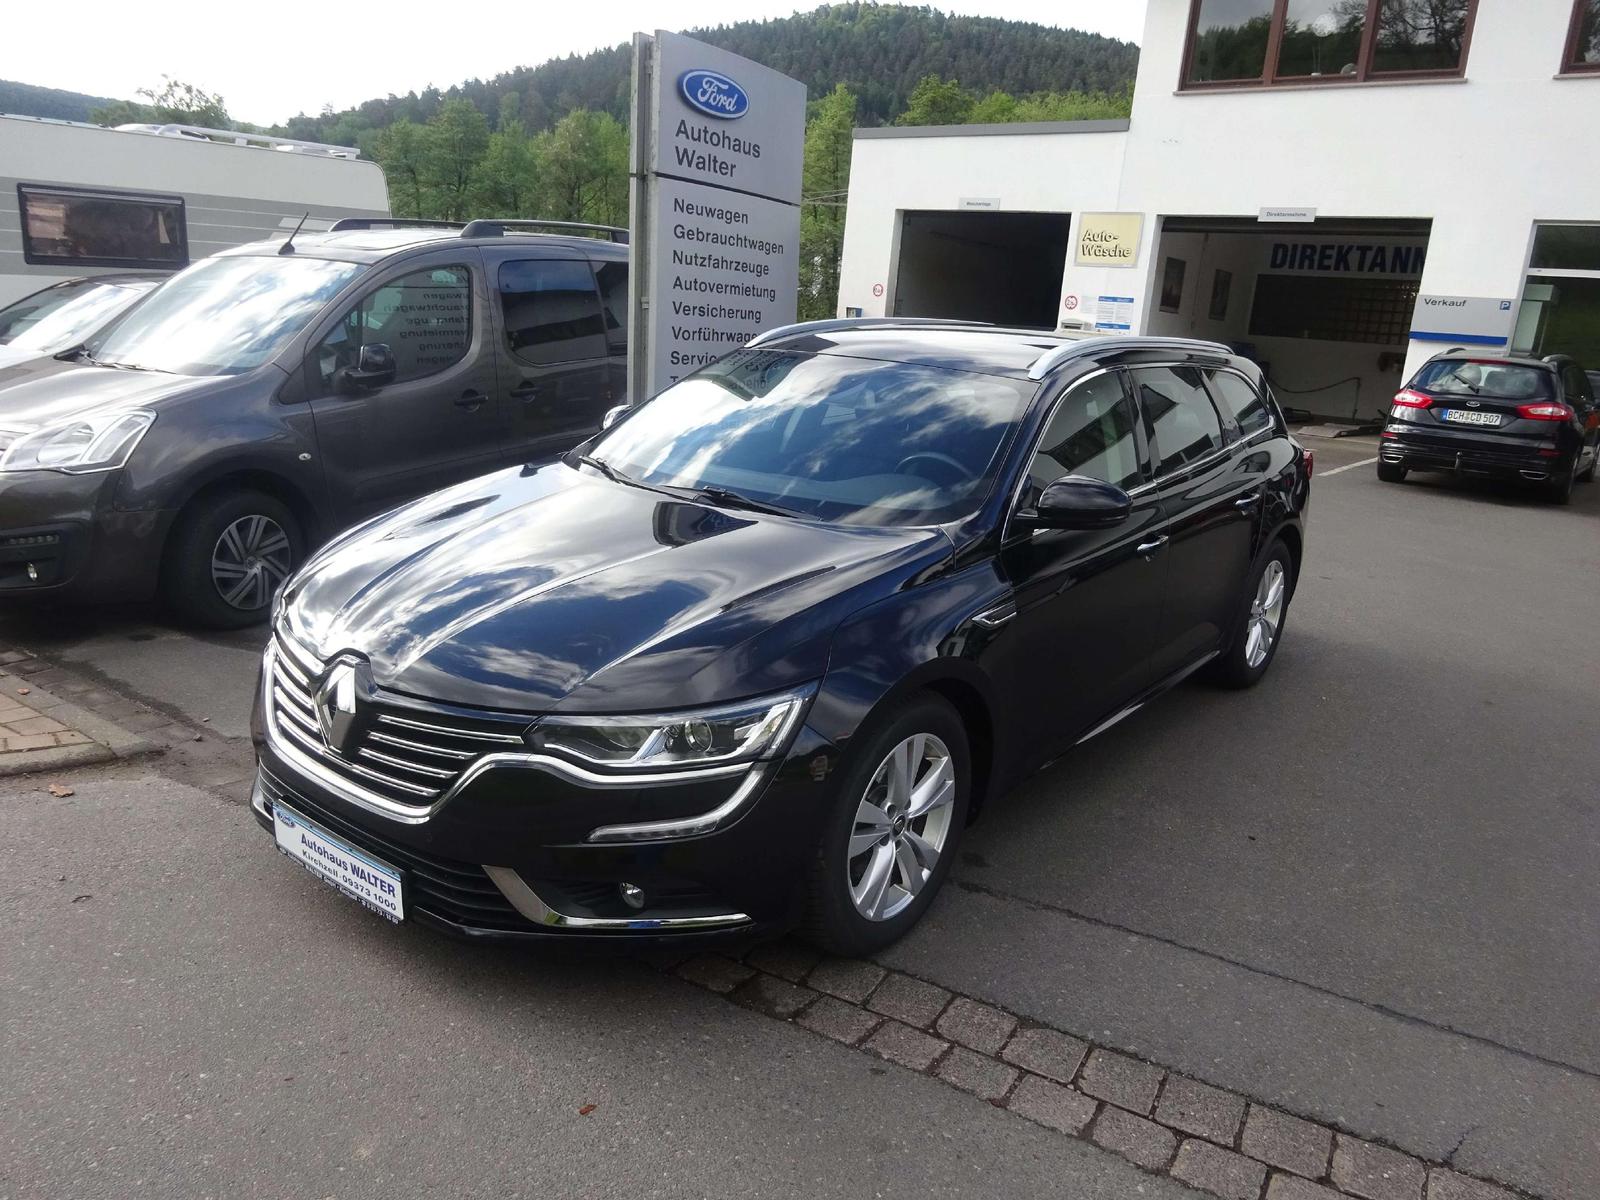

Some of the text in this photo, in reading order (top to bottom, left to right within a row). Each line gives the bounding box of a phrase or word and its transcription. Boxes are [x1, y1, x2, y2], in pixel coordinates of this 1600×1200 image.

[697, 77, 738, 111] Ford
[675, 119, 761, 158] Autohaus
[675, 145, 736, 177] Walter
[673, 198, 748, 224] Neuwagen
[673, 224, 784, 255] Gebrauchtwagen
[1082, 230, 1119, 242] Auto-
[1081, 243, 1132, 257] Wäsche
[672, 250, 769, 277] Nutzfahrzeuge
[672, 275, 776, 302] Autovermietung
[672, 301, 761, 324] Versicherung
[1424, 298, 1467, 307] Verkauf
[671, 326, 759, 344] Vorführwage
[670, 351, 719, 365] Servic
[1447, 410, 1500, 424] BCH CD 507
[301, 833, 348, 871] Autohaus
[350, 860, 396, 898] WALTER
[302, 849, 338, 878] Kirchzell
[342, 876, 371, 897] 09373
[374, 894, 397, 911] 1000
